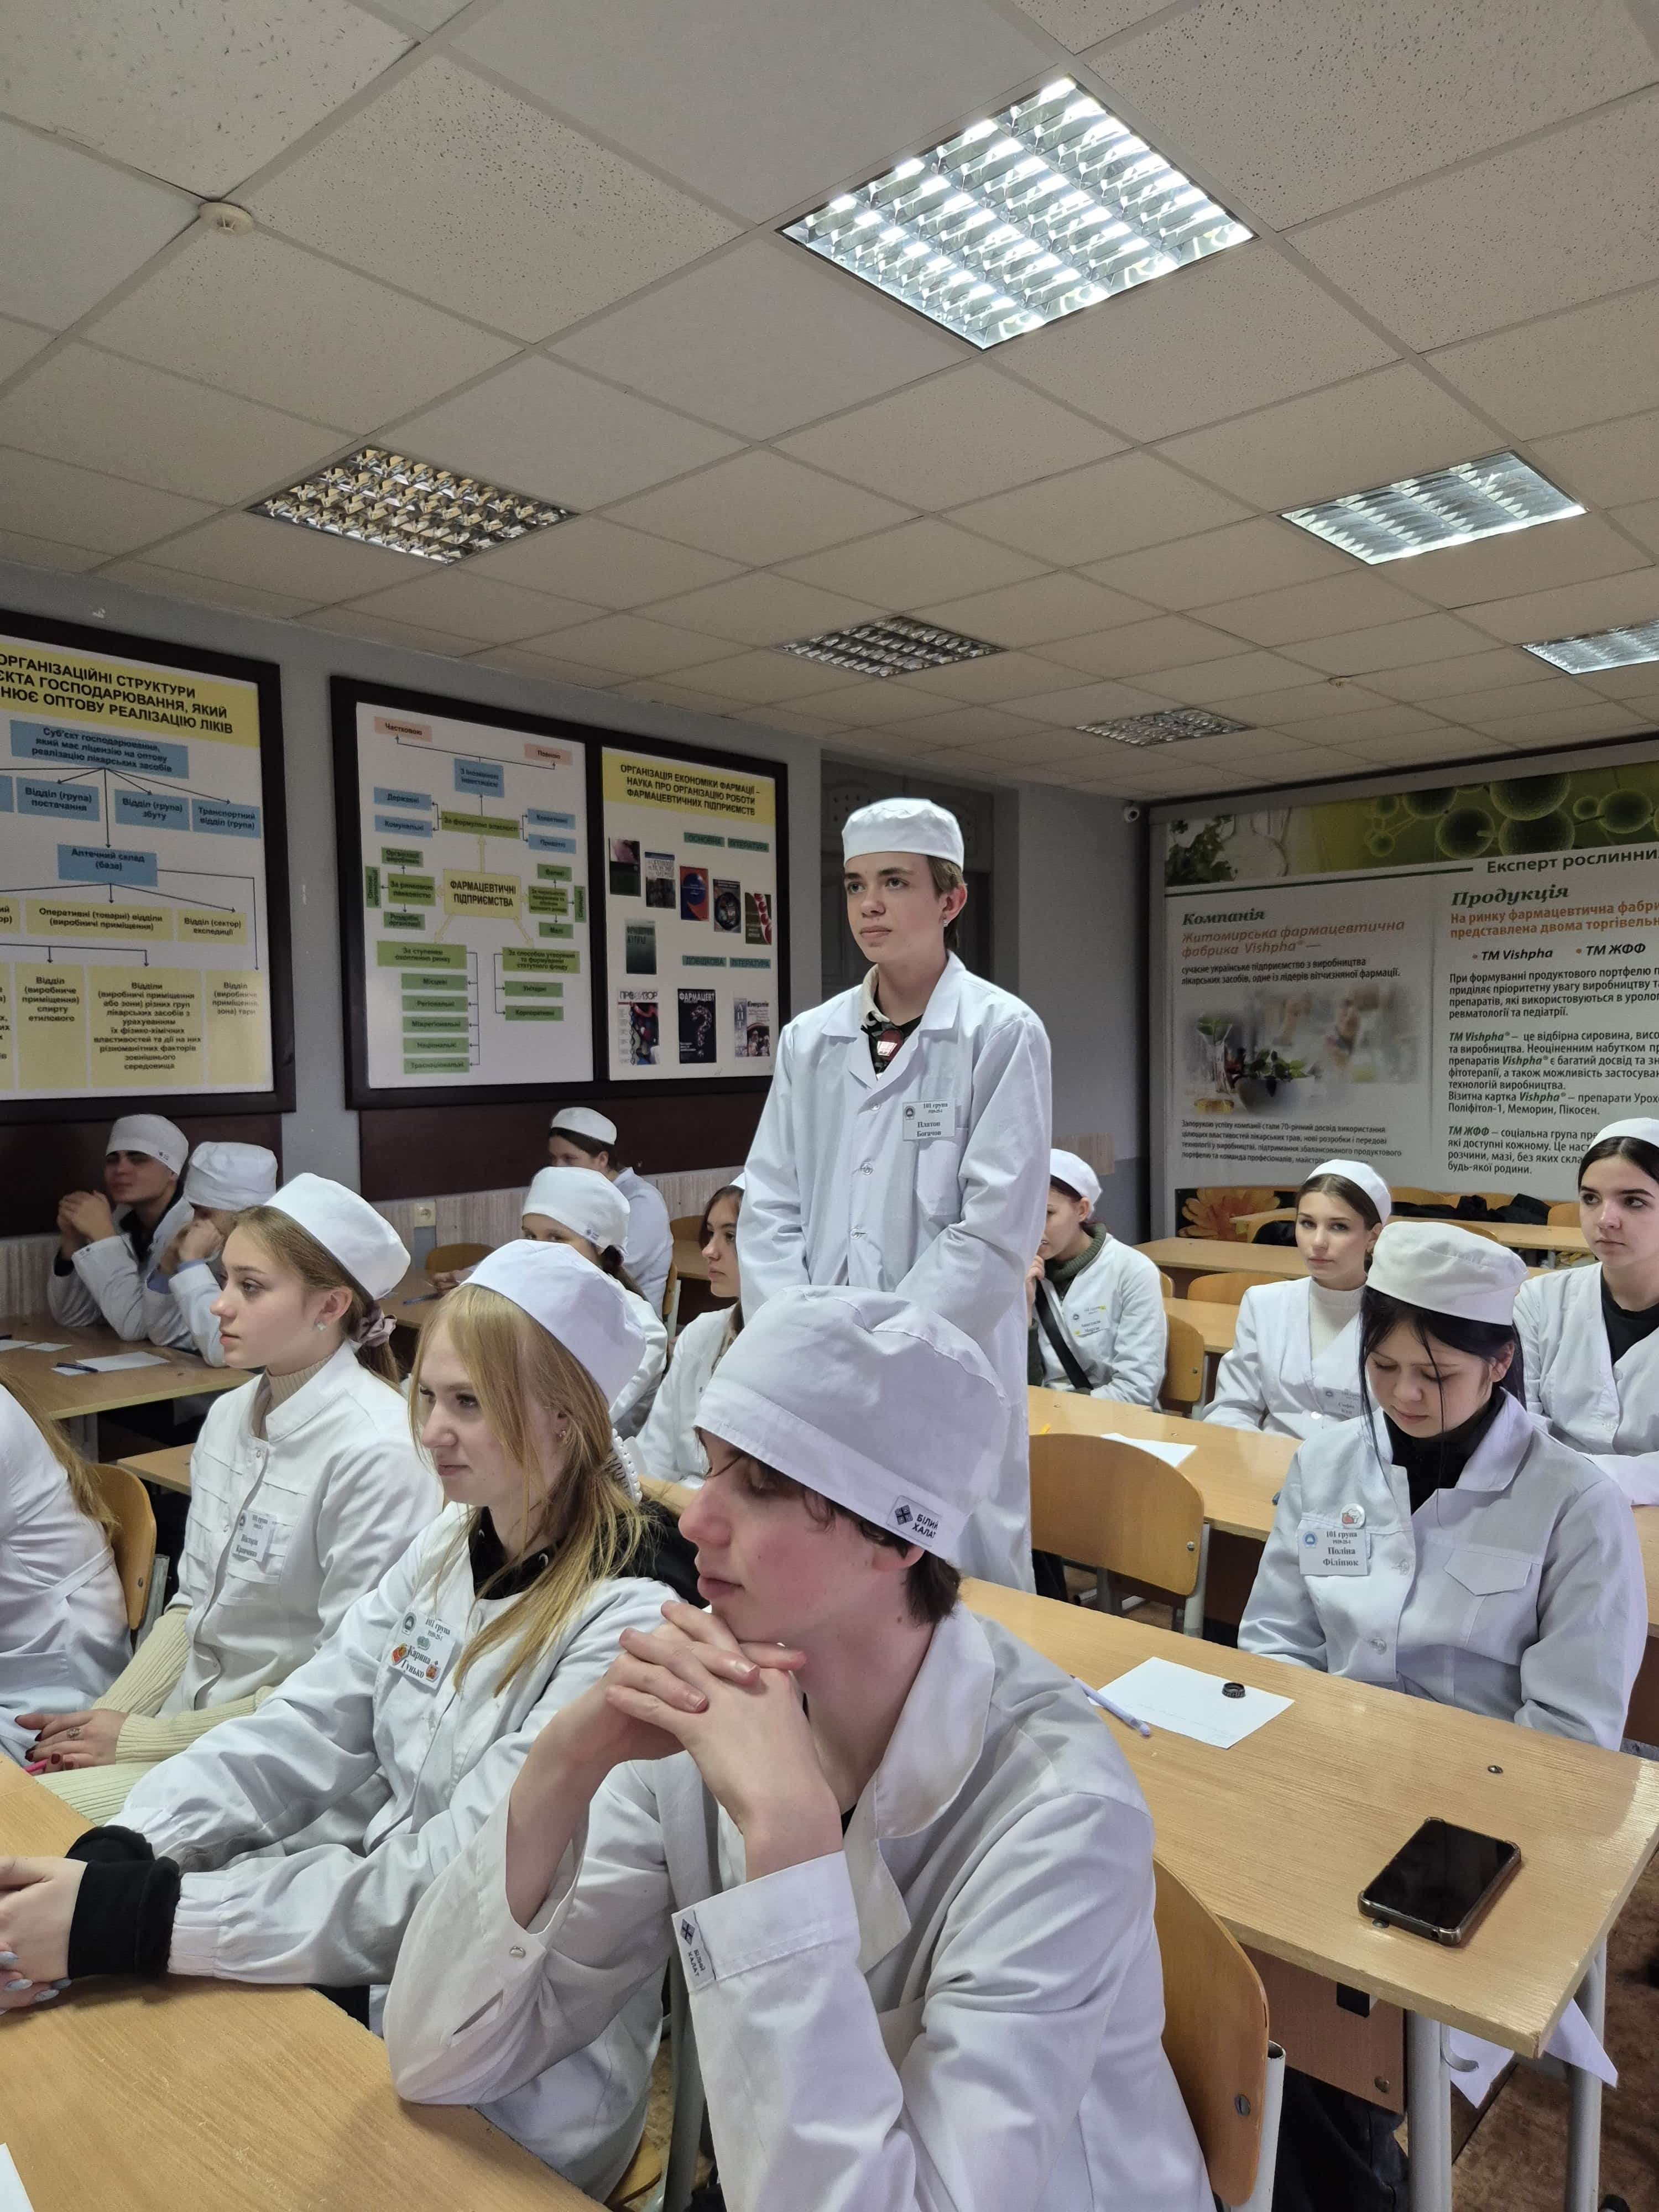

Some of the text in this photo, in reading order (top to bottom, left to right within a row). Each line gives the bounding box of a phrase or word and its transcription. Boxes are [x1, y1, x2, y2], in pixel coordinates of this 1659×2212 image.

[117, 675, 196, 698] СТРУКТУРИ
[40, 677, 188, 713] ГОСПОДАРЮВАННЯ,
[192, 703, 227, 719] ЯКИЙ
[44, 693, 105, 713] ОПТОВУ
[109, 704, 196, 728] РЕАЛІЗАЦІЮ
[200, 719, 233, 734] ЛІКІВ
[620, 764, 755, 795] ОРГАНІЗАЦІЯ ЕКОНОМІКИ ФАРМАЦІЇ
[25, 787, 92, 804] Відділ (група)
[627, 777, 755, 805] НАУКА ПРО ОРГАНІЗАЦІЮ РОБОТИ
[32, 800, 87, 811] постачання
[627, 789, 755, 816] ФАРМАЦЕВТИЧНИХ ПІДПРИЄМСТВ
[71, 848, 145, 863] Аптечний склад
[1488, 849, 1659, 873] Експерт рослинни
[450, 880, 517, 895] ФАРМАЦЕВТИЧНІ
[454, 893, 514, 907] ПІДПРИЄМСТВА
[1451, 884, 1569, 908] Продукція
[39, 907, 89, 917] Оперативні
[1182, 907, 1265, 925] Компанія
[1451, 913, 1465, 924] На
[1468, 911, 1506, 925] ринку
[1509, 904, 1614, 922] фармацевтична
[1182, 921, 1405, 943] Житомирська фармацевтична
[1450, 924, 1537, 941] представлена
[1540, 921, 1583, 935] двома
[1182, 945, 1239, 960] фабрика
[1503, 948, 1553, 962] Vishpha
[1608, 942, 1646, 956] ЖФФ
[1182, 965, 1209, 974] сучасне
[1211, 962, 1250, 974] українське
[1251, 960, 1305, 972] підприємство
[1313, 958, 1366, 970] виробництва
[36, 977, 65, 985] Відділ
[1181, 975, 1220, 985] лікарських
[1253, 974, 1271, 983] одне
[1272, 972, 1279, 981] із
[1280, 971, 1309, 983] лідерів
[1310, 969, 1358, 981] вітчизняної
[1449, 966, 1651, 985] При формуванні продуктового портфелю
[1449, 979, 1651, 997] приділяє пріоритетну увагу виробництву
[679, 992, 715, 1001] ФАРМАЦЕВТ
[1449, 997, 1504, 1008] препаратів,
[1506, 995, 1519, 1005] які
[1521, 993, 1614, 1005] використовуються
[1616, 994, 1623, 1003] в
[1449, 1006, 1569, 1020] ревматології та педіатрії.
[1524, 1033, 1535, 1042] це
[1537, 1030, 1579, 1043] відбірна
[1582, 1031, 1633, 1043] сировина,
[1460, 1044, 1525, 1055] виробництва.
[1527, 1043, 1593, 1055] Неоціненним
[1596, 1042, 1646, 1055] набутком
[1449, 1056, 1500, 1067] препаратів
[1550, 1057, 1556, 1066] є
[1557, 1055, 1597, 1066] багатий
[1598, 1055, 1632, 1067] досвід
[1449, 1068, 1501, 1079] фітотерапії,
[1504, 1070, 1509, 1078] а
[1511, 1070, 1541, 1078] також
[1543, 1067, 1603, 1078] можливість
[1449, 1079, 1567, 1092] технологій виробництва.
[1449, 1091, 1483, 1102] Візитна
[1485, 1093, 1516, 1104] картка
[1578, 1094, 1631, 1105] препарати
[1449, 1102, 1600, 1117] Поліфітол-1, Меморин, Пікосен.
[1463, 1126, 1490, 1136] ЖФФ
[1501, 1129, 1548, 1140] соціальна
[1551, 1130, 1578, 1141] група
[1448, 1138, 1461, 1148] які
[1463, 1139, 1504, 1150] доступні
[1505, 1141, 1551, 1152] кожному.
[1554, 1142, 1567, 1152] Це
[1448, 1150, 1489, 1162] розчини,
[1491, 1151, 1515, 1163] мазі,
[1517, 1151, 1533, 1162] без
[1536, 1154, 1559, 1163] яких
[1448, 1161, 1532, 1175] будь-якої родини.
[917, 1514, 938, 1530] БІЛИЙ
[1328, 1546, 1356, 1555] Поліна
[435, 1623, 451, 1635] група
[408, 1646, 431, 1665] Карина
[401, 1660, 424, 1678] Гунько
